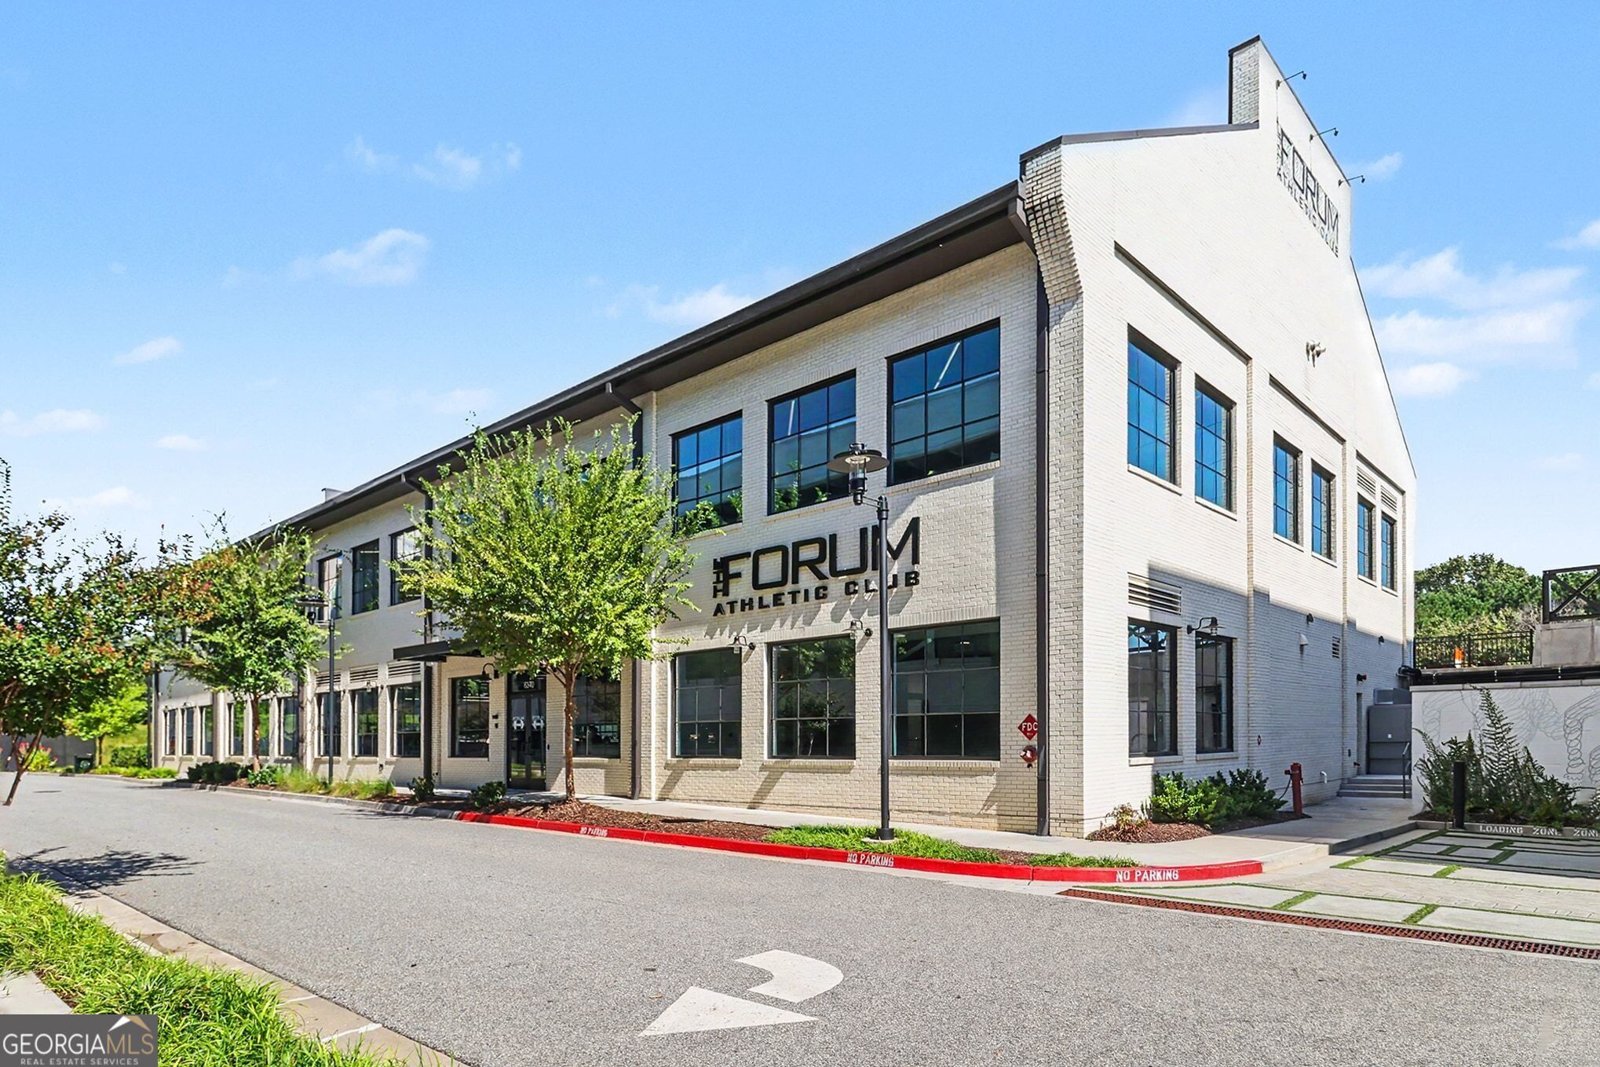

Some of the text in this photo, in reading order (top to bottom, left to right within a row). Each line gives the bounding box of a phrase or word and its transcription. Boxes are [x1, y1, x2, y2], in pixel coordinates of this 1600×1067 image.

[1280, 128, 1339, 244] FORUM
[722, 516, 920, 597] FORUM
[713, 571, 920, 617] ATHLETIC CLUB
[1021, 722, 1038, 731] FDC
[1479, 825, 1562, 836] LOADING ZON
[847, 853, 894, 866] NO PARKING
[1116, 869, 1179, 882] NO PARKING
